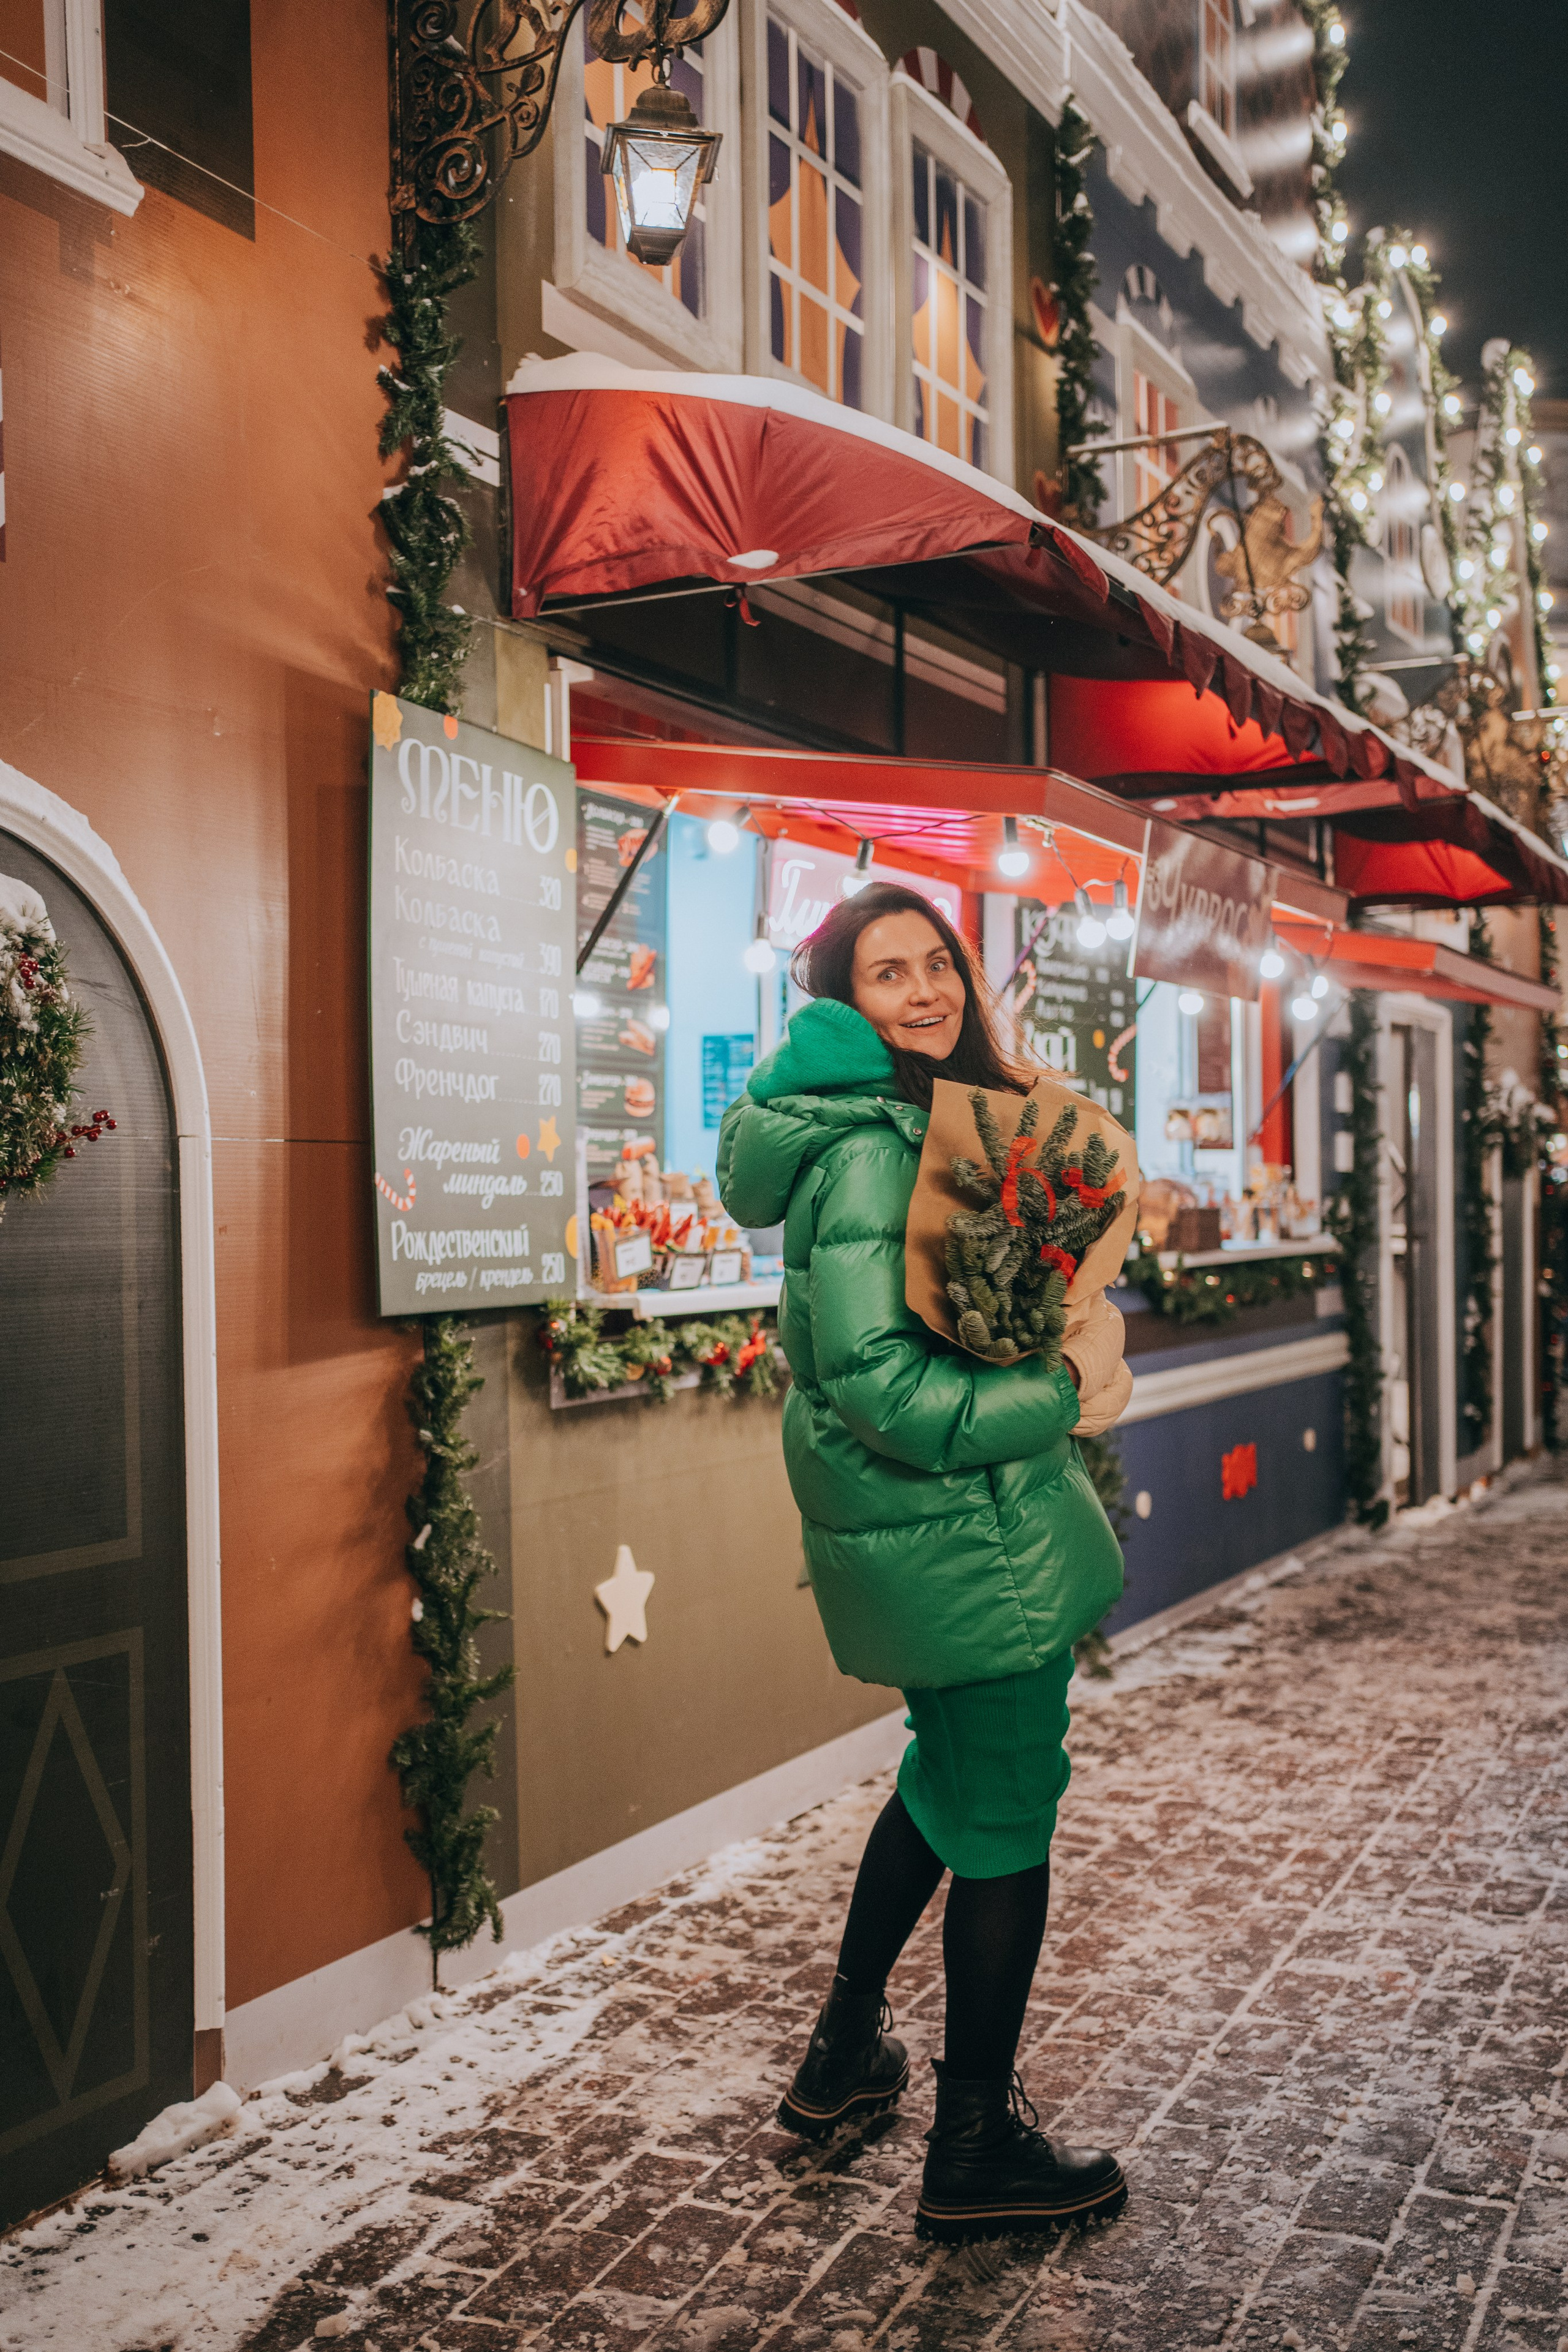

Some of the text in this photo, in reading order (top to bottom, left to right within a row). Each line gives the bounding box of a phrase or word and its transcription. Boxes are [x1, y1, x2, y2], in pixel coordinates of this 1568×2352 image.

[398, 737, 559, 854] МЕНЮ
[394, 835, 501, 896] Колбаска
[394, 884, 502, 943] Колбаска
[393, 956, 459, 1002] Тушеная
[467, 979, 526, 1017] капуста
[396, 1009, 489, 1055] Сэндвич
[394, 1057, 500, 1104] Френчдог
[398, 1126, 502, 1171] Жареный
[442, 1173, 528, 1210] миндаль
[390, 1219, 530, 1267] Рождественский
[415, 1270, 468, 1296] брецель
[479, 1266, 534, 1292] крендель
